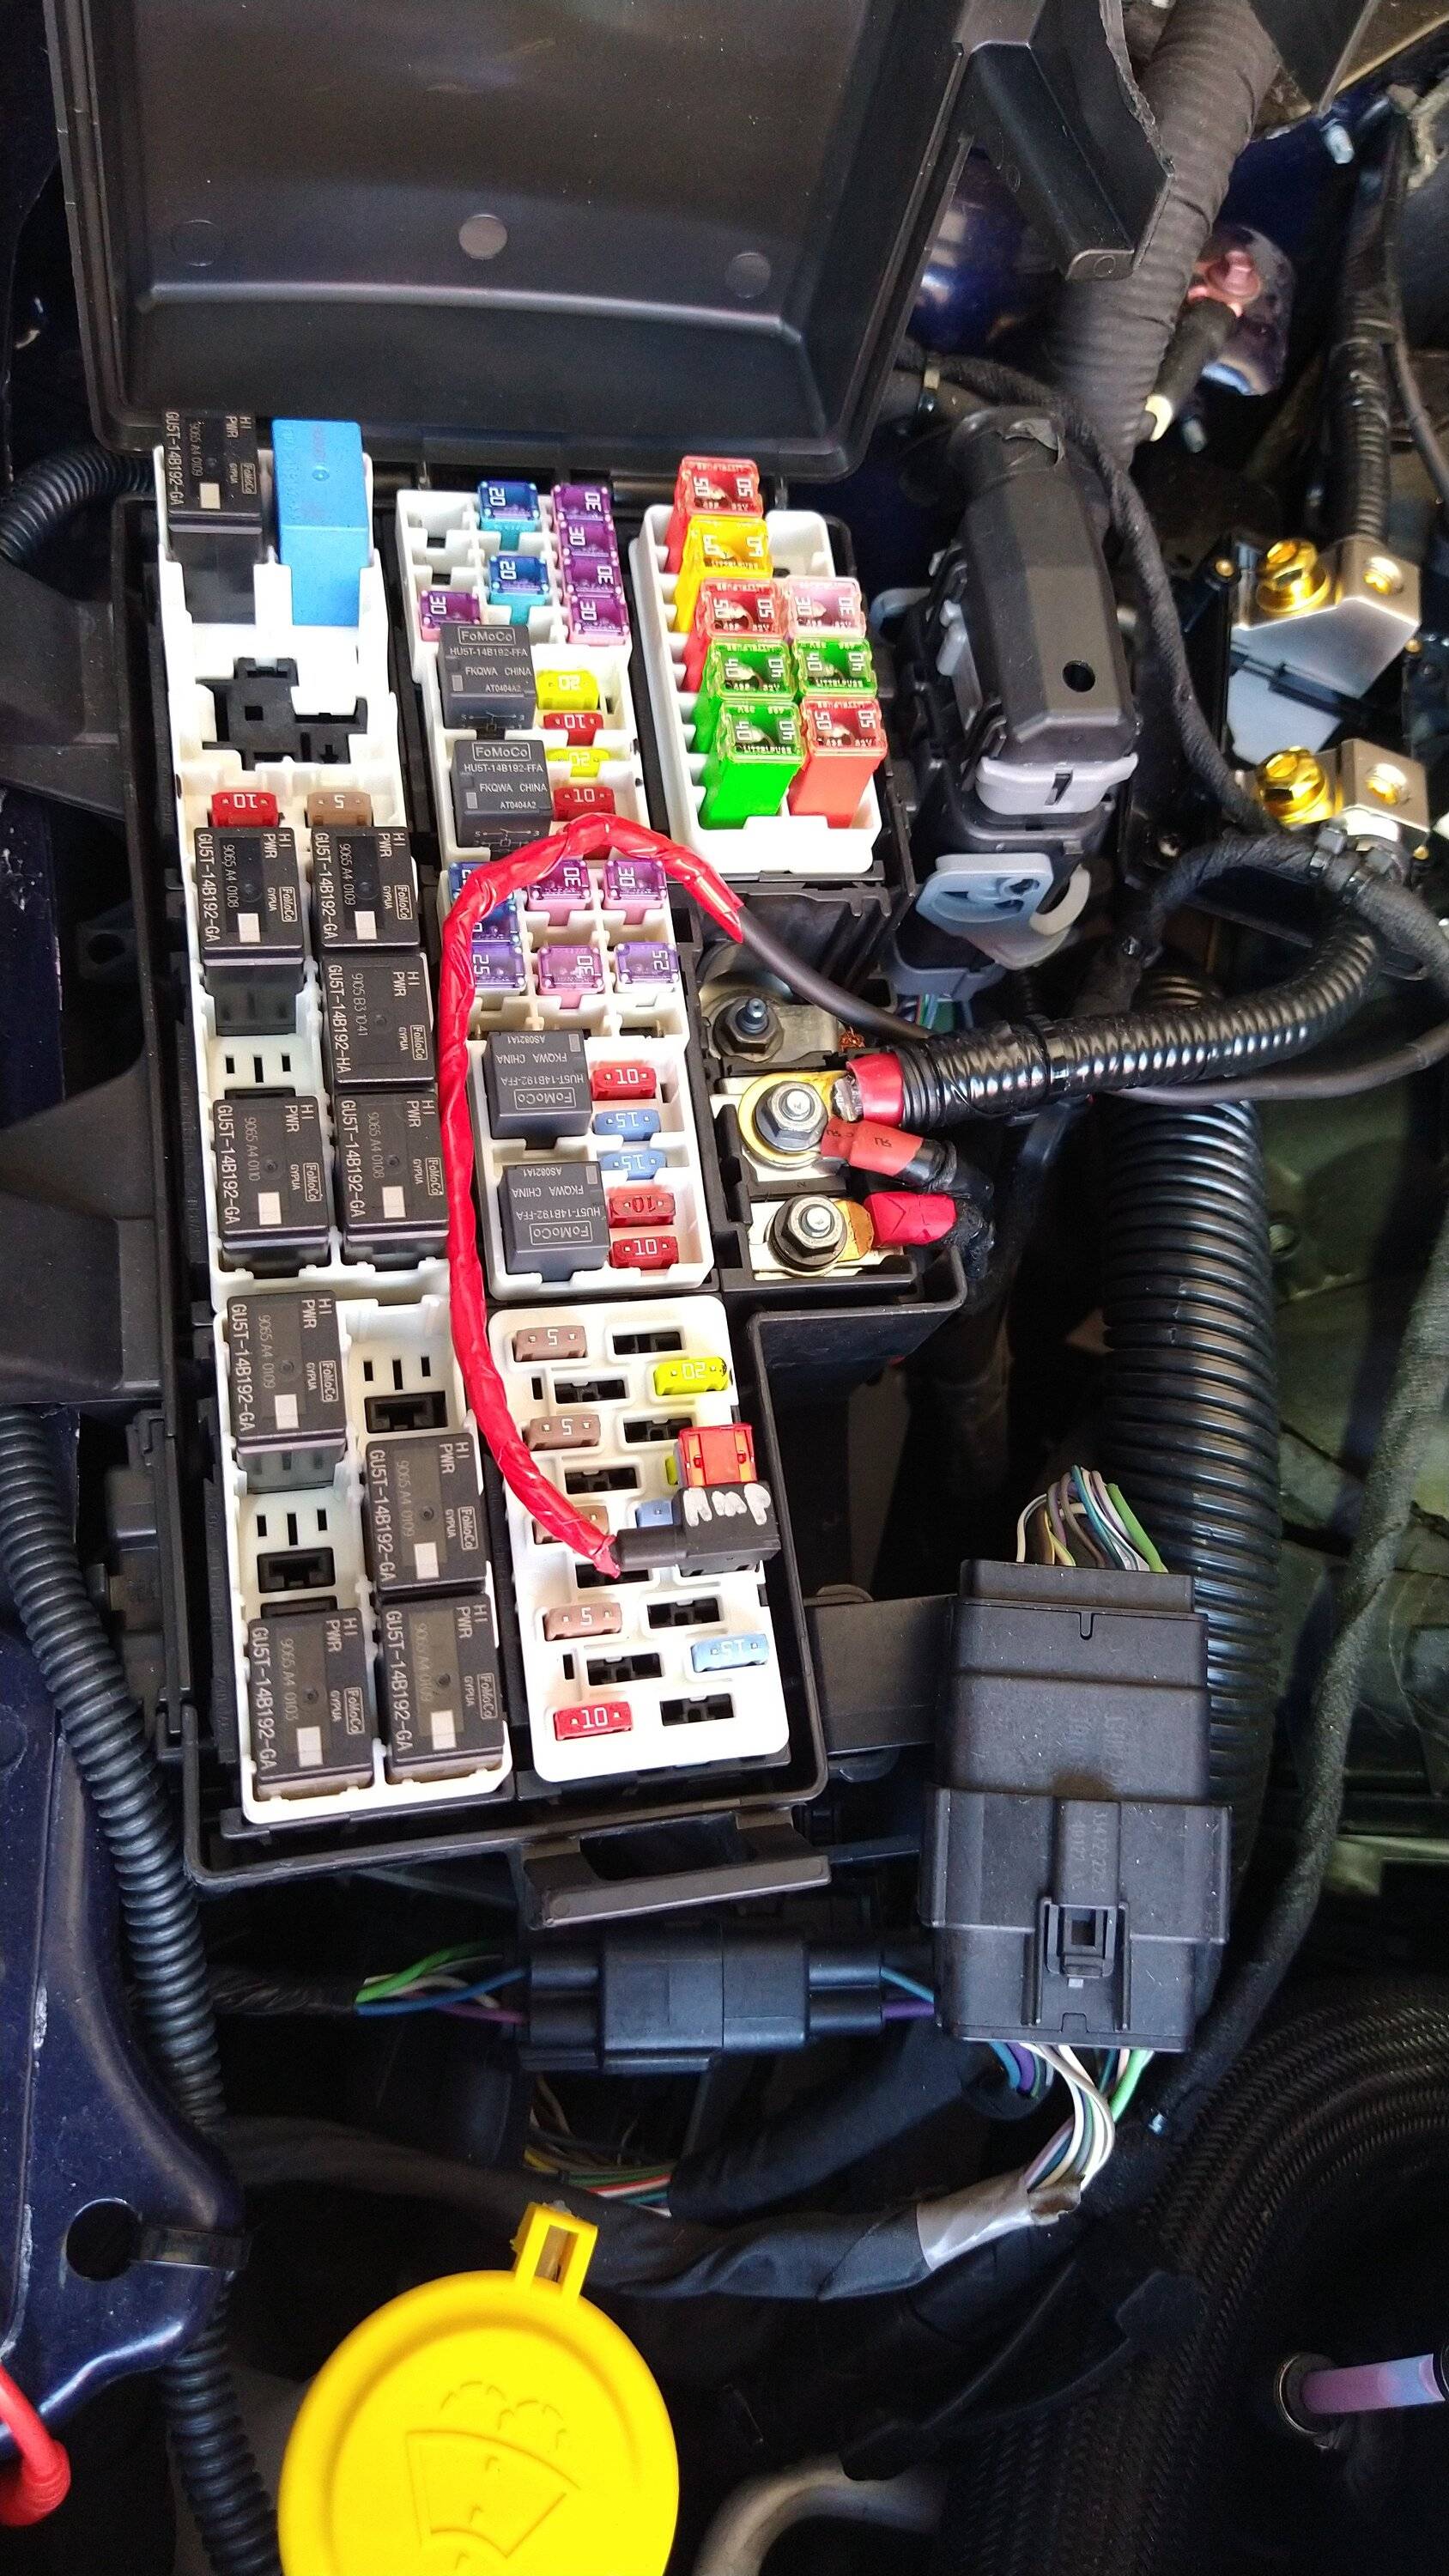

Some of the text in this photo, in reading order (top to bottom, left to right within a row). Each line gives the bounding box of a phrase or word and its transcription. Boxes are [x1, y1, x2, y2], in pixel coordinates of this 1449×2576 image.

[226, 416, 239, 439] PWR
[239, 416, 252, 429] HI
[166, 411, 185, 506] GU5T-14B192-GA
[488, 487, 506, 507] 20
[736, 478, 753, 498] 50
[585, 492, 602, 511] 30
[569, 526, 585, 546] 30
[500, 561, 517, 580] 20
[597, 566, 614, 585] 30
[430, 596, 447, 616] 30
[580, 601, 597, 621] 30
[757, 598, 774, 618] 50
[461, 630, 512, 641] FoMoCo
[450, 647, 529, 657] HU5T-14B192-FFA
[465, 666, 532, 677] FKQWA CHINA
[725, 659, 741, 678] 40
[768, 659, 784, 677] 40
[806, 653, 822, 671] 40
[848, 653, 865, 671] 40
[564, 714, 586, 728] 10
[815, 711, 832, 730] 50
[858, 711, 876, 728] 50
[736, 720, 752, 741] 40
[779, 721, 796, 740] 40
[475, 746, 528, 757] FoMoCo
[464, 763, 544, 773] HU5T-14B192-FFA
[480, 783, 548, 793] FKQWA CHINA
[573, 788, 595, 803] 10
[233, 793, 258, 809] 10
[334, 794, 346, 809] 5
[264, 833, 277, 859] PWR
[278, 833, 291, 848] HI
[379, 833, 392, 858] PWR
[392, 832, 405, 847] HI
[338, 844, 351, 867] 9065
[222, 844, 239, 908] 9065 A4 0108
[341, 868, 353, 882] A4
[563, 866, 580, 887] 30
[618, 866, 635, 887] 30
[199, 833, 221, 943] GU5T-14B192-GA
[314, 832, 339, 940] GU5T-14B192-GA
[472, 954, 490, 975] 25
[577, 955, 594, 975] 30
[652, 950, 669, 971] 25
[393, 971, 407, 998] PWR
[407, 971, 420, 986] HI
[354, 998, 367, 1012] B3
[327, 964, 352, 1074] GU5T-14B192-HA
[495, 1053, 567, 1065] FKQWA CHINA
[500, 1073, 584, 1086] HU5T-14B192-FFA
[615, 1068, 639, 1084] 10
[517, 1091, 573, 1104] FoMoCo
[300, 1104, 314, 1120] HI
[407, 1100, 421, 1127] PWR
[421, 1100, 435, 1115] HI
[285, 1105, 300, 1133] PWR
[615, 1111, 640, 1127] 15
[244, 1117, 258, 1142] 9065
[246, 1143, 259, 1157] A4
[370, 1139, 383, 1153] A4
[217, 1105, 241, 1225] GU5T-14B192-GA
[341, 1100, 366, 1218] GU5T-14B192-GA
[372, 1156, 385, 1179] 0108
[621, 1153, 645, 1170] 15
[512, 1185, 584, 1198] FKQWA CHINA
[516, 1207, 601, 1220] HU5T-14B192-FFA
[533, 1224, 590, 1239] FoMoCo
[634, 1239, 658, 1255] 10
[302, 1298, 318, 1329] PWR
[318, 1297, 332, 1315] HI
[547, 1328, 559, 1346] 5
[258, 1314, 276, 1389] 9065 A4 0109
[230, 1303, 256, 1432] GU5T-14B192-GA
[682, 1361, 706, 1380] 20
[561, 1418, 573, 1436] 5
[440, 1443, 455, 1474] PWR
[455, 1441, 470, 1460] HI
[369, 1449, 397, 1583] GU5T-14B192-GA
[456, 1606, 473, 1639] PWR
[473, 1604, 488, 1623] HI
[580, 1607, 592, 1625] 5
[325, 1619, 343, 1653] PWR
[342, 1617, 358, 1637] HI
[720, 1639, 745, 1656] 15
[385, 1610, 414, 1752] GU5T-14B192-GA
[250, 1626, 277, 1771] GU5T-14B192-GA
[581, 1707, 608, 1729] 10
